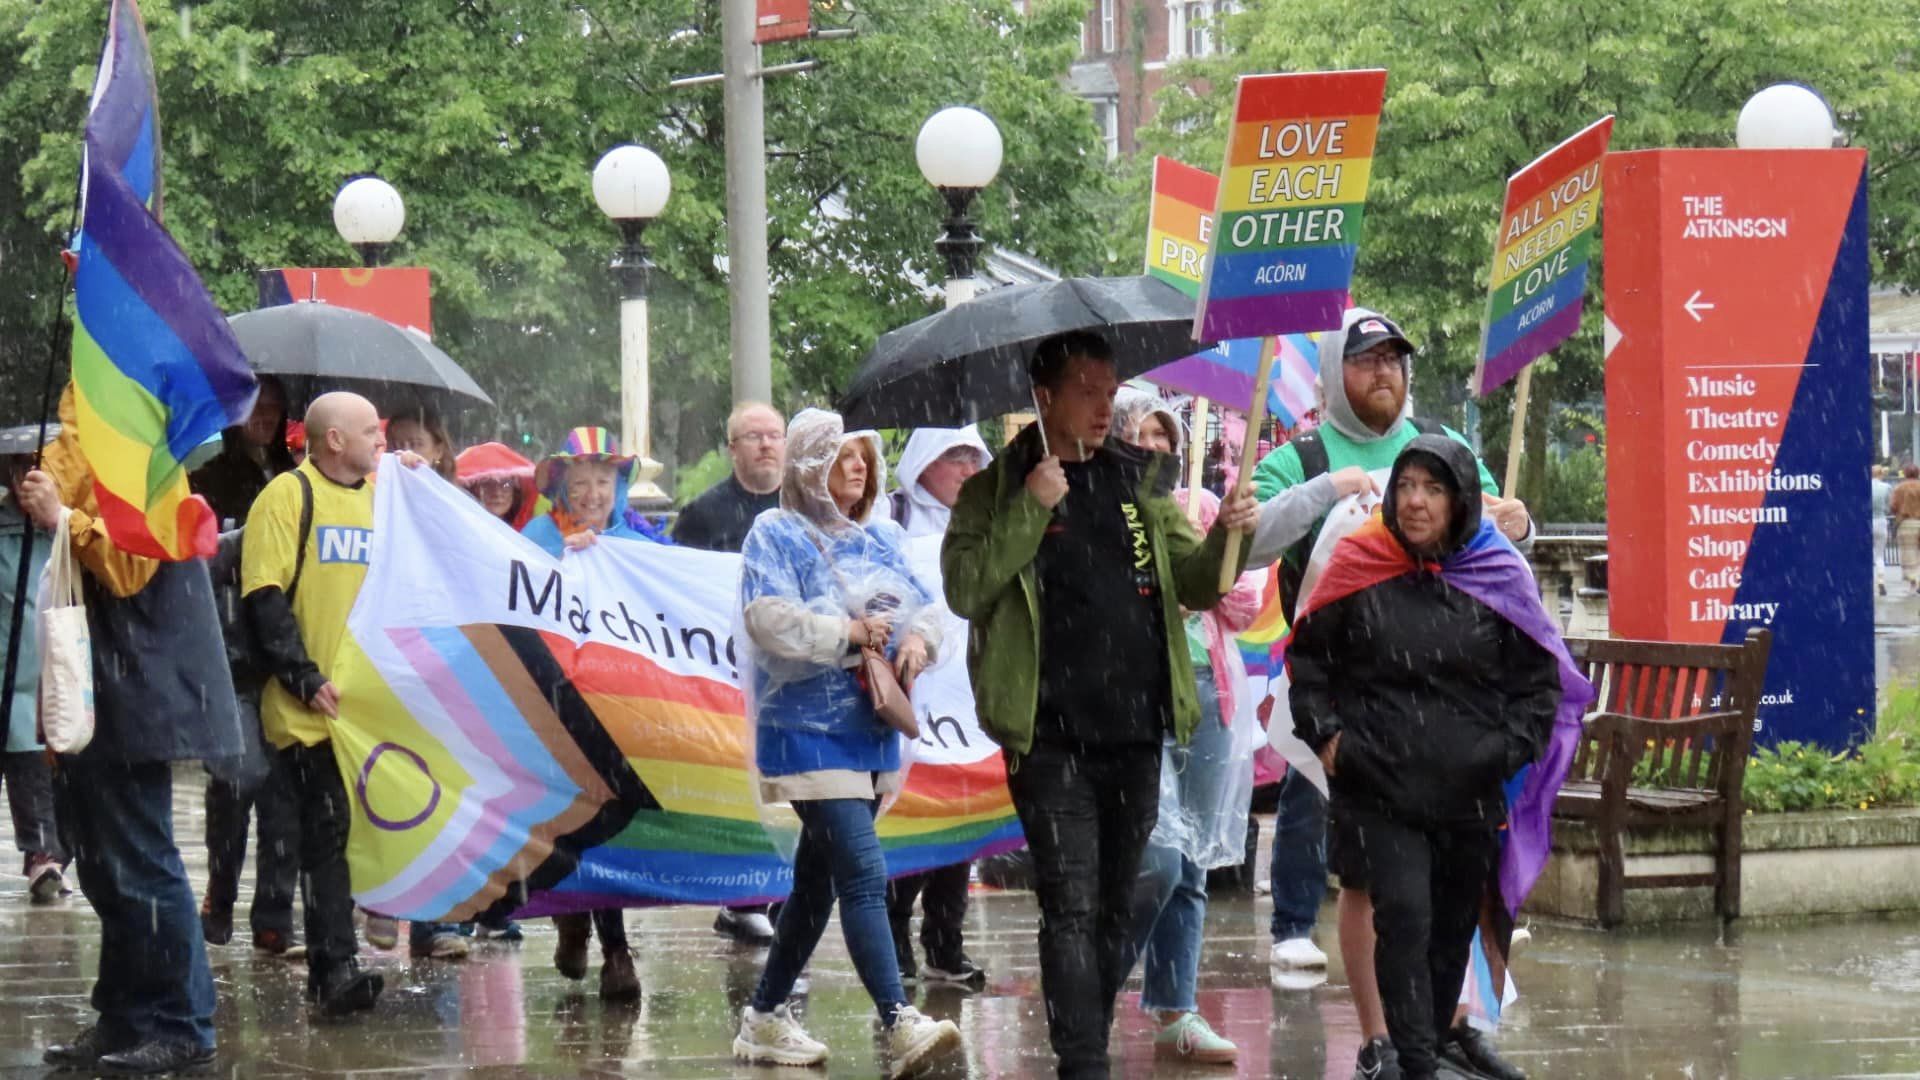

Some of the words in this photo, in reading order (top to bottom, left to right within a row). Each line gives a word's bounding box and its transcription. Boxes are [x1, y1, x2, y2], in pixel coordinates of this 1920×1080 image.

[1258, 121, 1347, 158] LOVE
[1248, 164, 1342, 204] EACH
[1505, 200, 1544, 246] ALL
[1549, 163, 1599, 214] YOU
[1682, 196, 1723, 216] THE
[1231, 208, 1345, 248] OTHER
[1504, 220, 1566, 280] NEED
[1570, 201, 1591, 234] IS
[1682, 218, 1787, 239] ATKINSON
[1255, 263, 1306, 285] ACORN
[1513, 246, 1572, 306] LOVE
[1517, 295, 1554, 331] ACORN
[1686, 374, 1756, 397] Music
[1686, 406, 1778, 429] Theatre
[1686, 437, 1781, 464] Comedy
[1688, 469, 1822, 493] Exhibitions
[1688, 504, 1788, 526] Museum
[322, 528, 373, 561] NH
[1688, 534, 1747, 561] Shop
[1688, 566, 1742, 590] Café
[1690, 598, 1780, 624] Library
